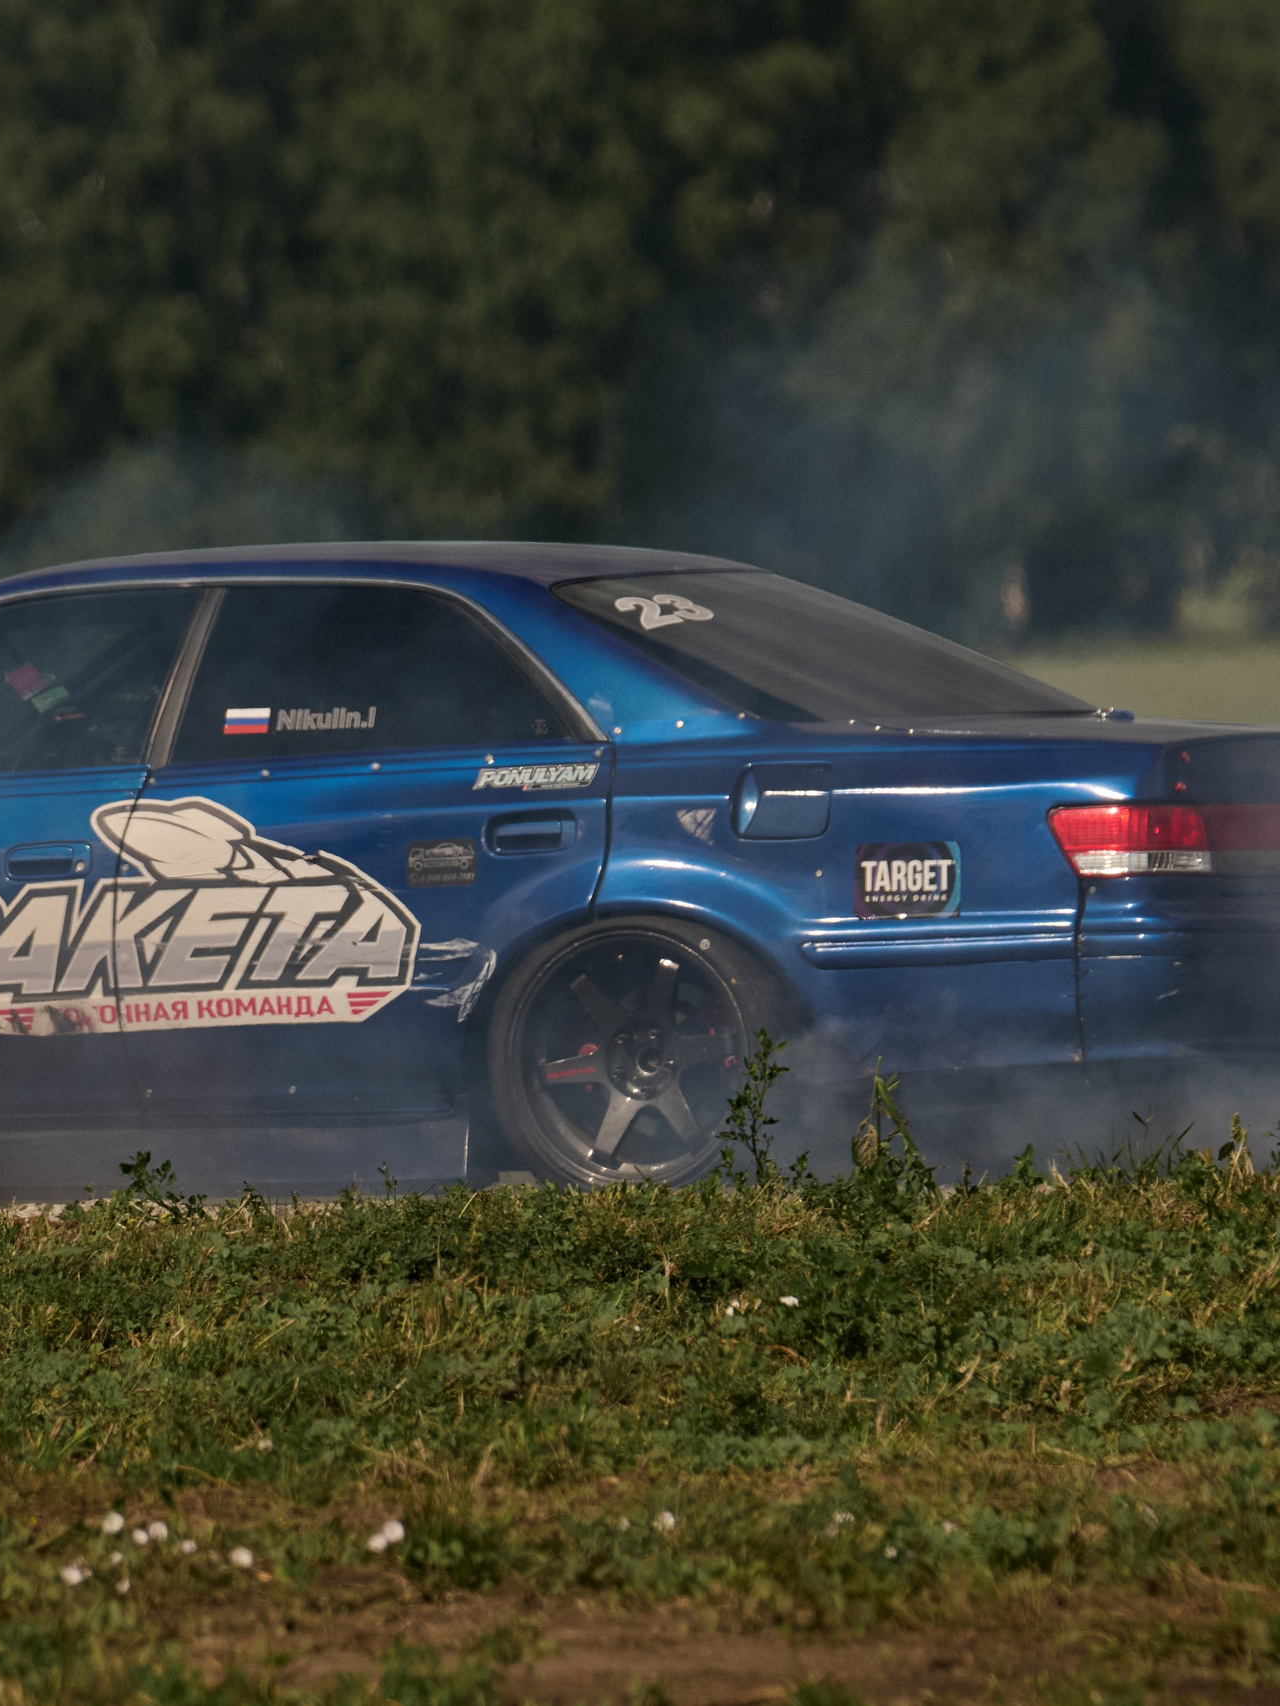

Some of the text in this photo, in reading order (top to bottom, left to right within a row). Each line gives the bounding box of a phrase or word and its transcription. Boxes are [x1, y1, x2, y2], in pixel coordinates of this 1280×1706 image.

[615, 594, 714, 630] 23
[478, 764, 597, 787] PONULYAM
[860, 858, 953, 893] TARGET
[197, 995, 336, 1020] КОМАНДА
